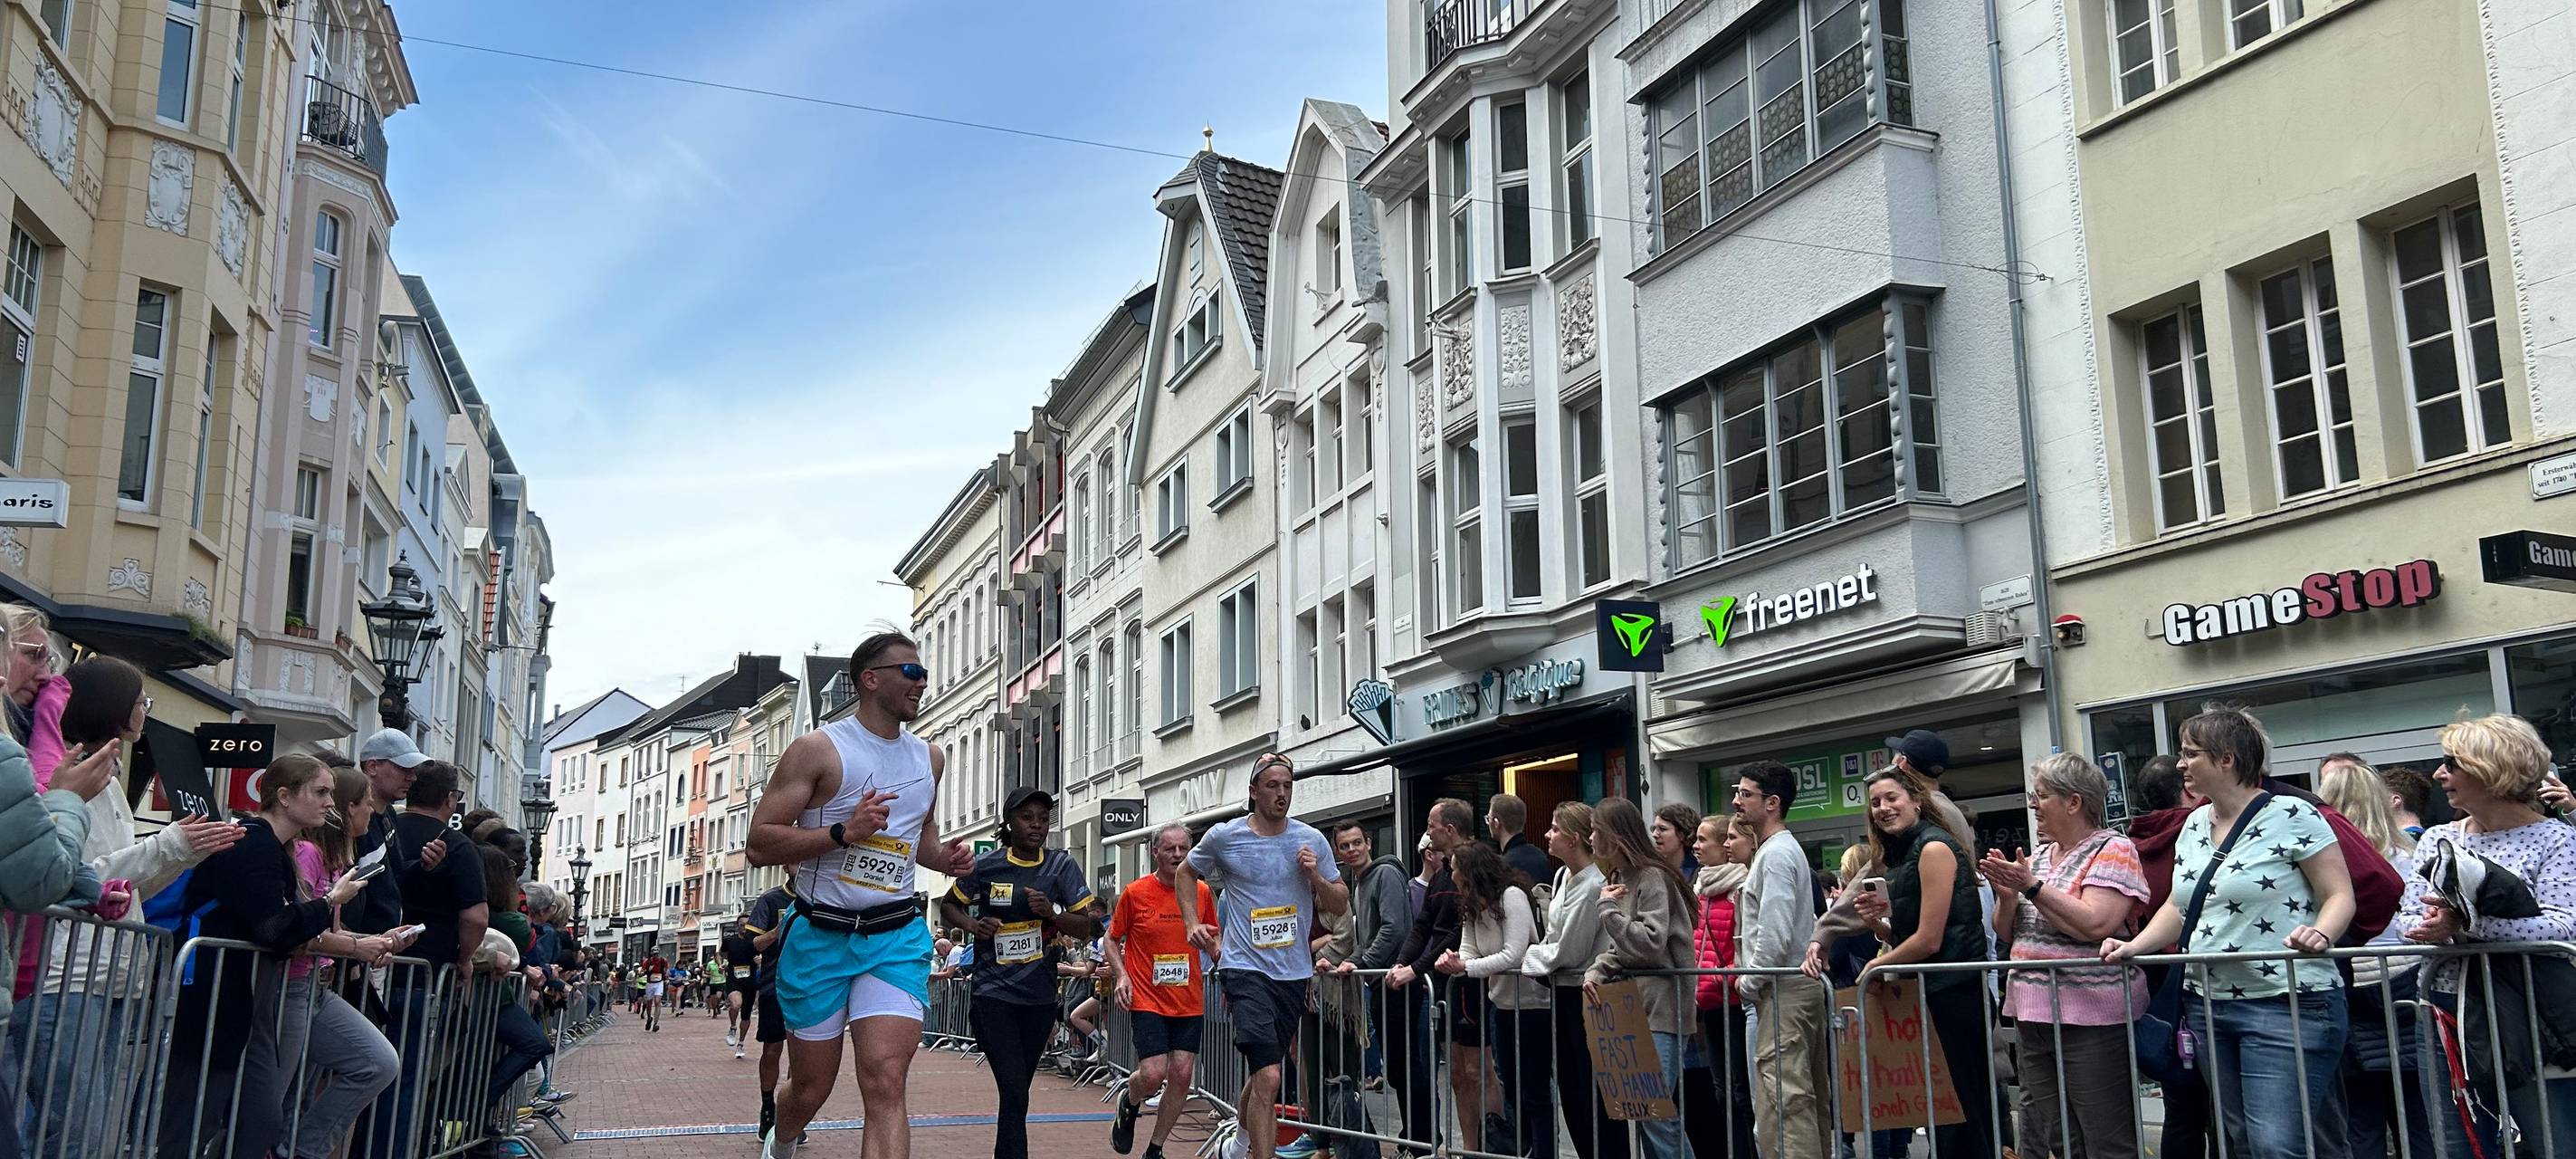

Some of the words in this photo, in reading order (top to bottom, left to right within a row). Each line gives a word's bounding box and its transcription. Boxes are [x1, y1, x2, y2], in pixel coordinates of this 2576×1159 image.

[0, 493, 53, 508] aris
[1744, 563, 1877, 633] freenet
[2162, 560, 2435, 646] GameStop
[1423, 682, 1479, 725] FRITES
[209, 739, 262, 752] zero
[1178, 768, 1226, 816] ONLY
[177, 790, 209, 818] zero
[1104, 812, 1140, 822] ONLY
[858, 856, 896, 875] 5929
[863, 872, 884, 883] Daniel
[1262, 923, 1289, 935] 5928
[1009, 937, 1031, 951] 2181
[1159, 967, 1182, 976] 2648
[1588, 1001, 1615, 1031] TOO
[1598, 1034, 1637, 1070] FAST
[1596, 1071, 1618, 1098] TO
[1621, 1102, 1651, 1118] FELIX
